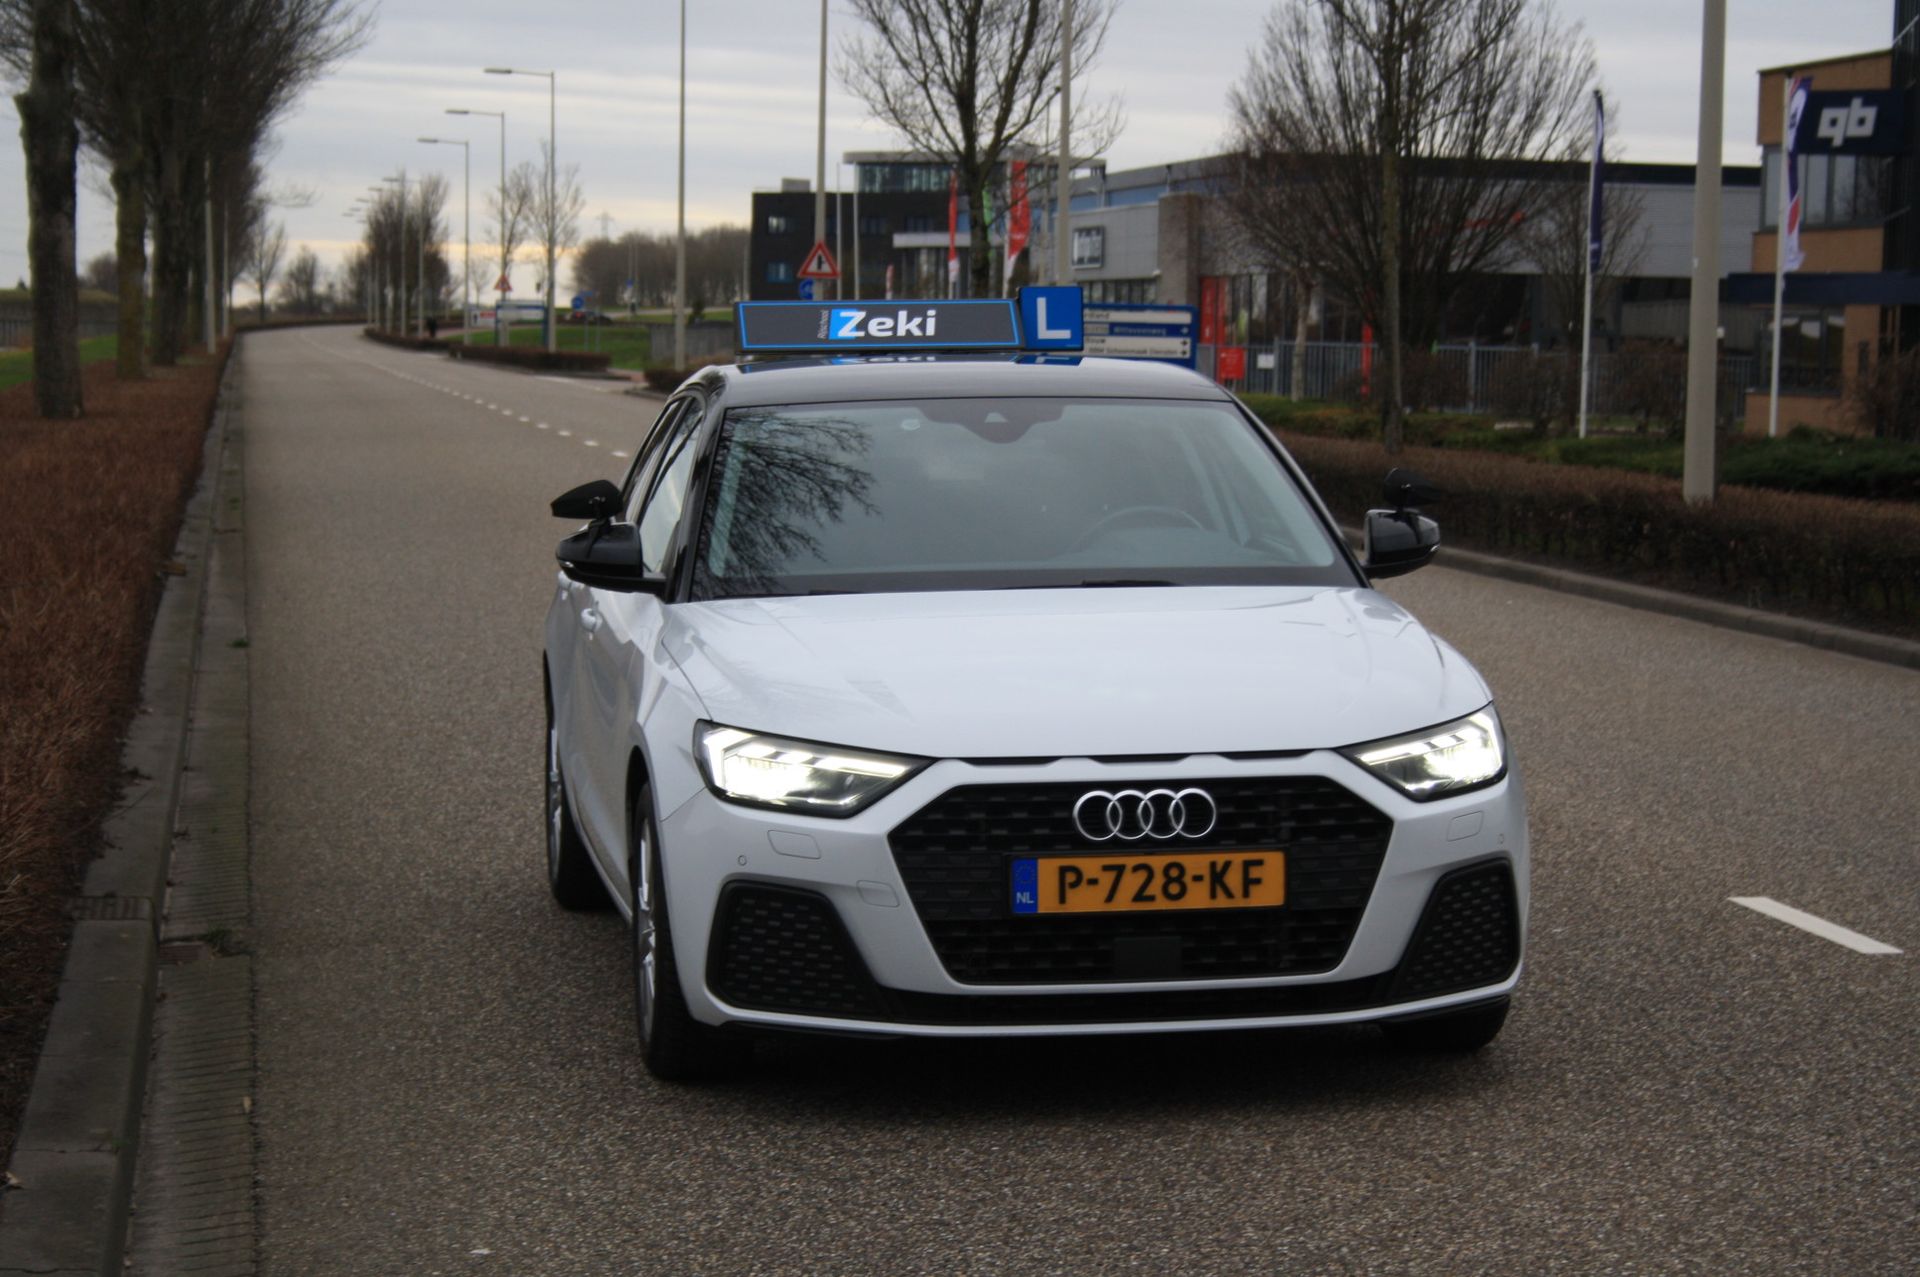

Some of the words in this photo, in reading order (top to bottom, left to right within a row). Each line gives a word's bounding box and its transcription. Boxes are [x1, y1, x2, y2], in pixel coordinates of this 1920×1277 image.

[1817, 97, 1878, 147] qb
[837, 309, 937, 337] Zeki
[1036, 297, 1071, 339] L
[1016, 892, 1034, 904] NL
[1058, 859, 1265, 904] P-728-KF
